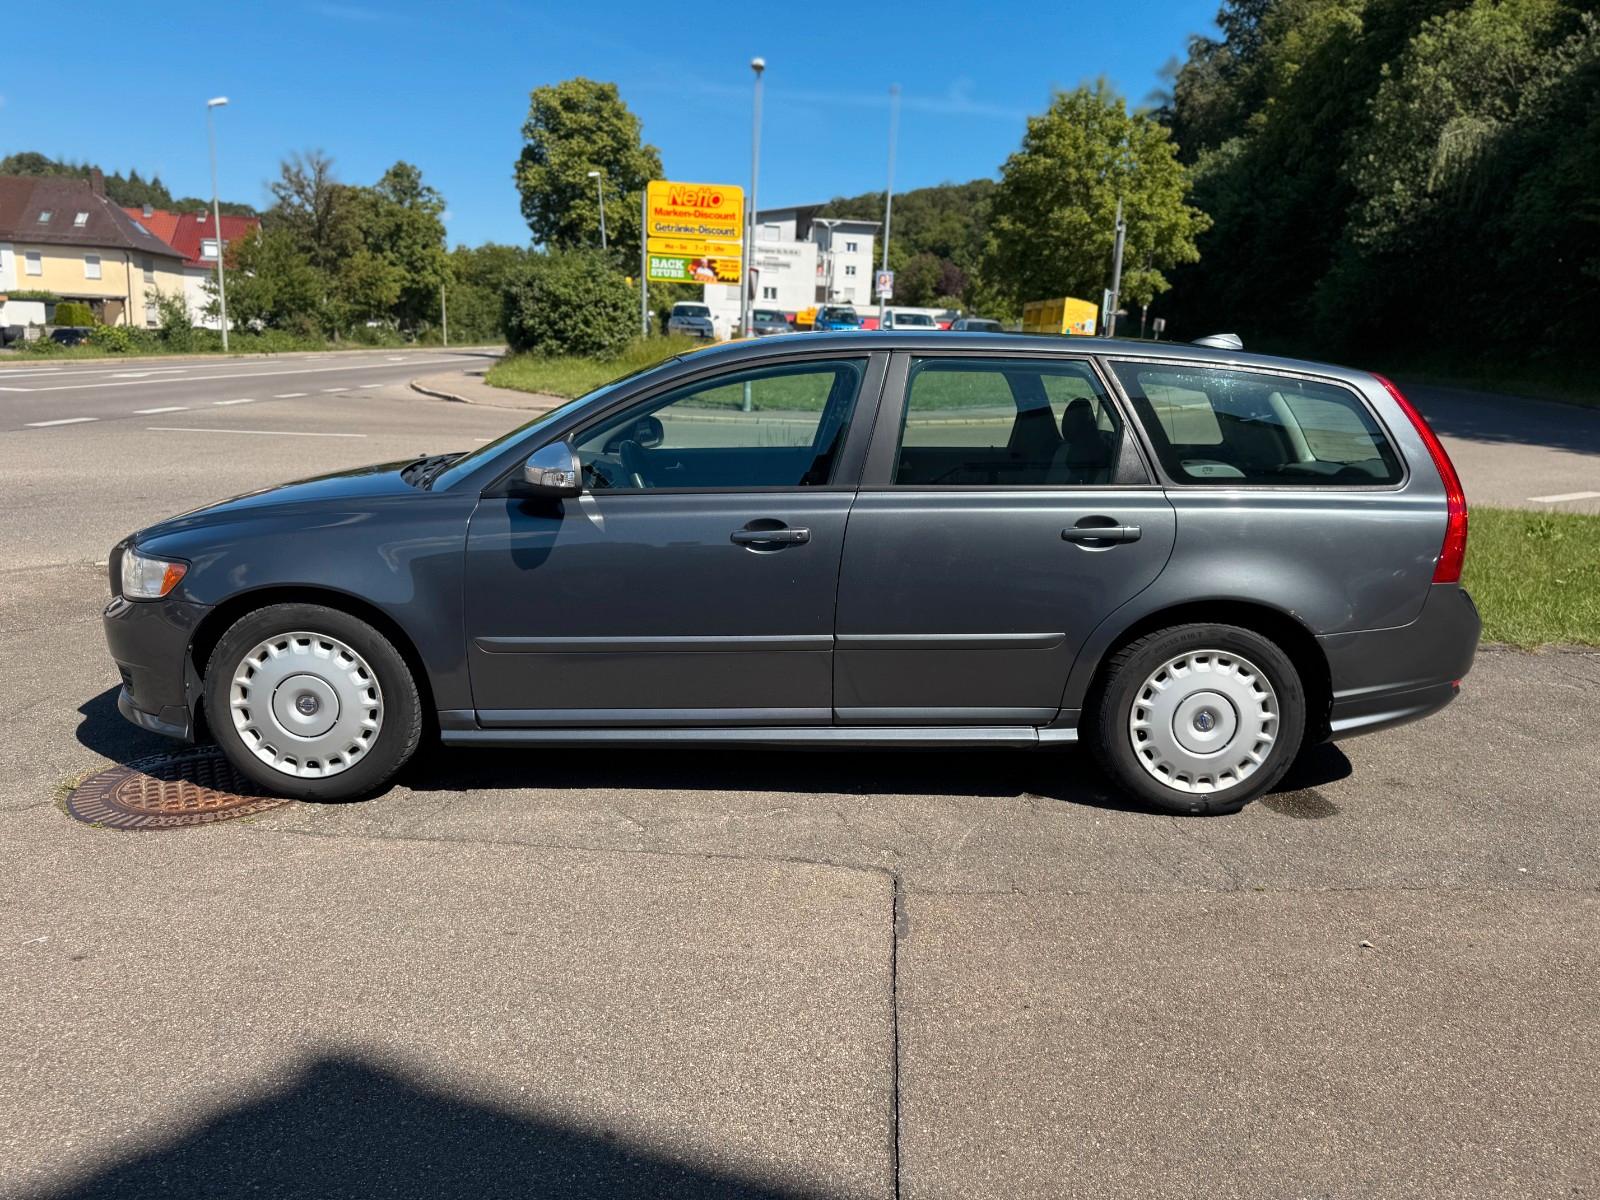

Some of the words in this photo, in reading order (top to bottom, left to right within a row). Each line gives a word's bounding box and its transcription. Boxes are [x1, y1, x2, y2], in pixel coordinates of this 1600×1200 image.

[668, 186, 724, 208] Netto
[654, 207, 736, 220] Marken-Discount
[651, 258, 685, 269] BACK
[651, 268, 685, 278] STUBE
